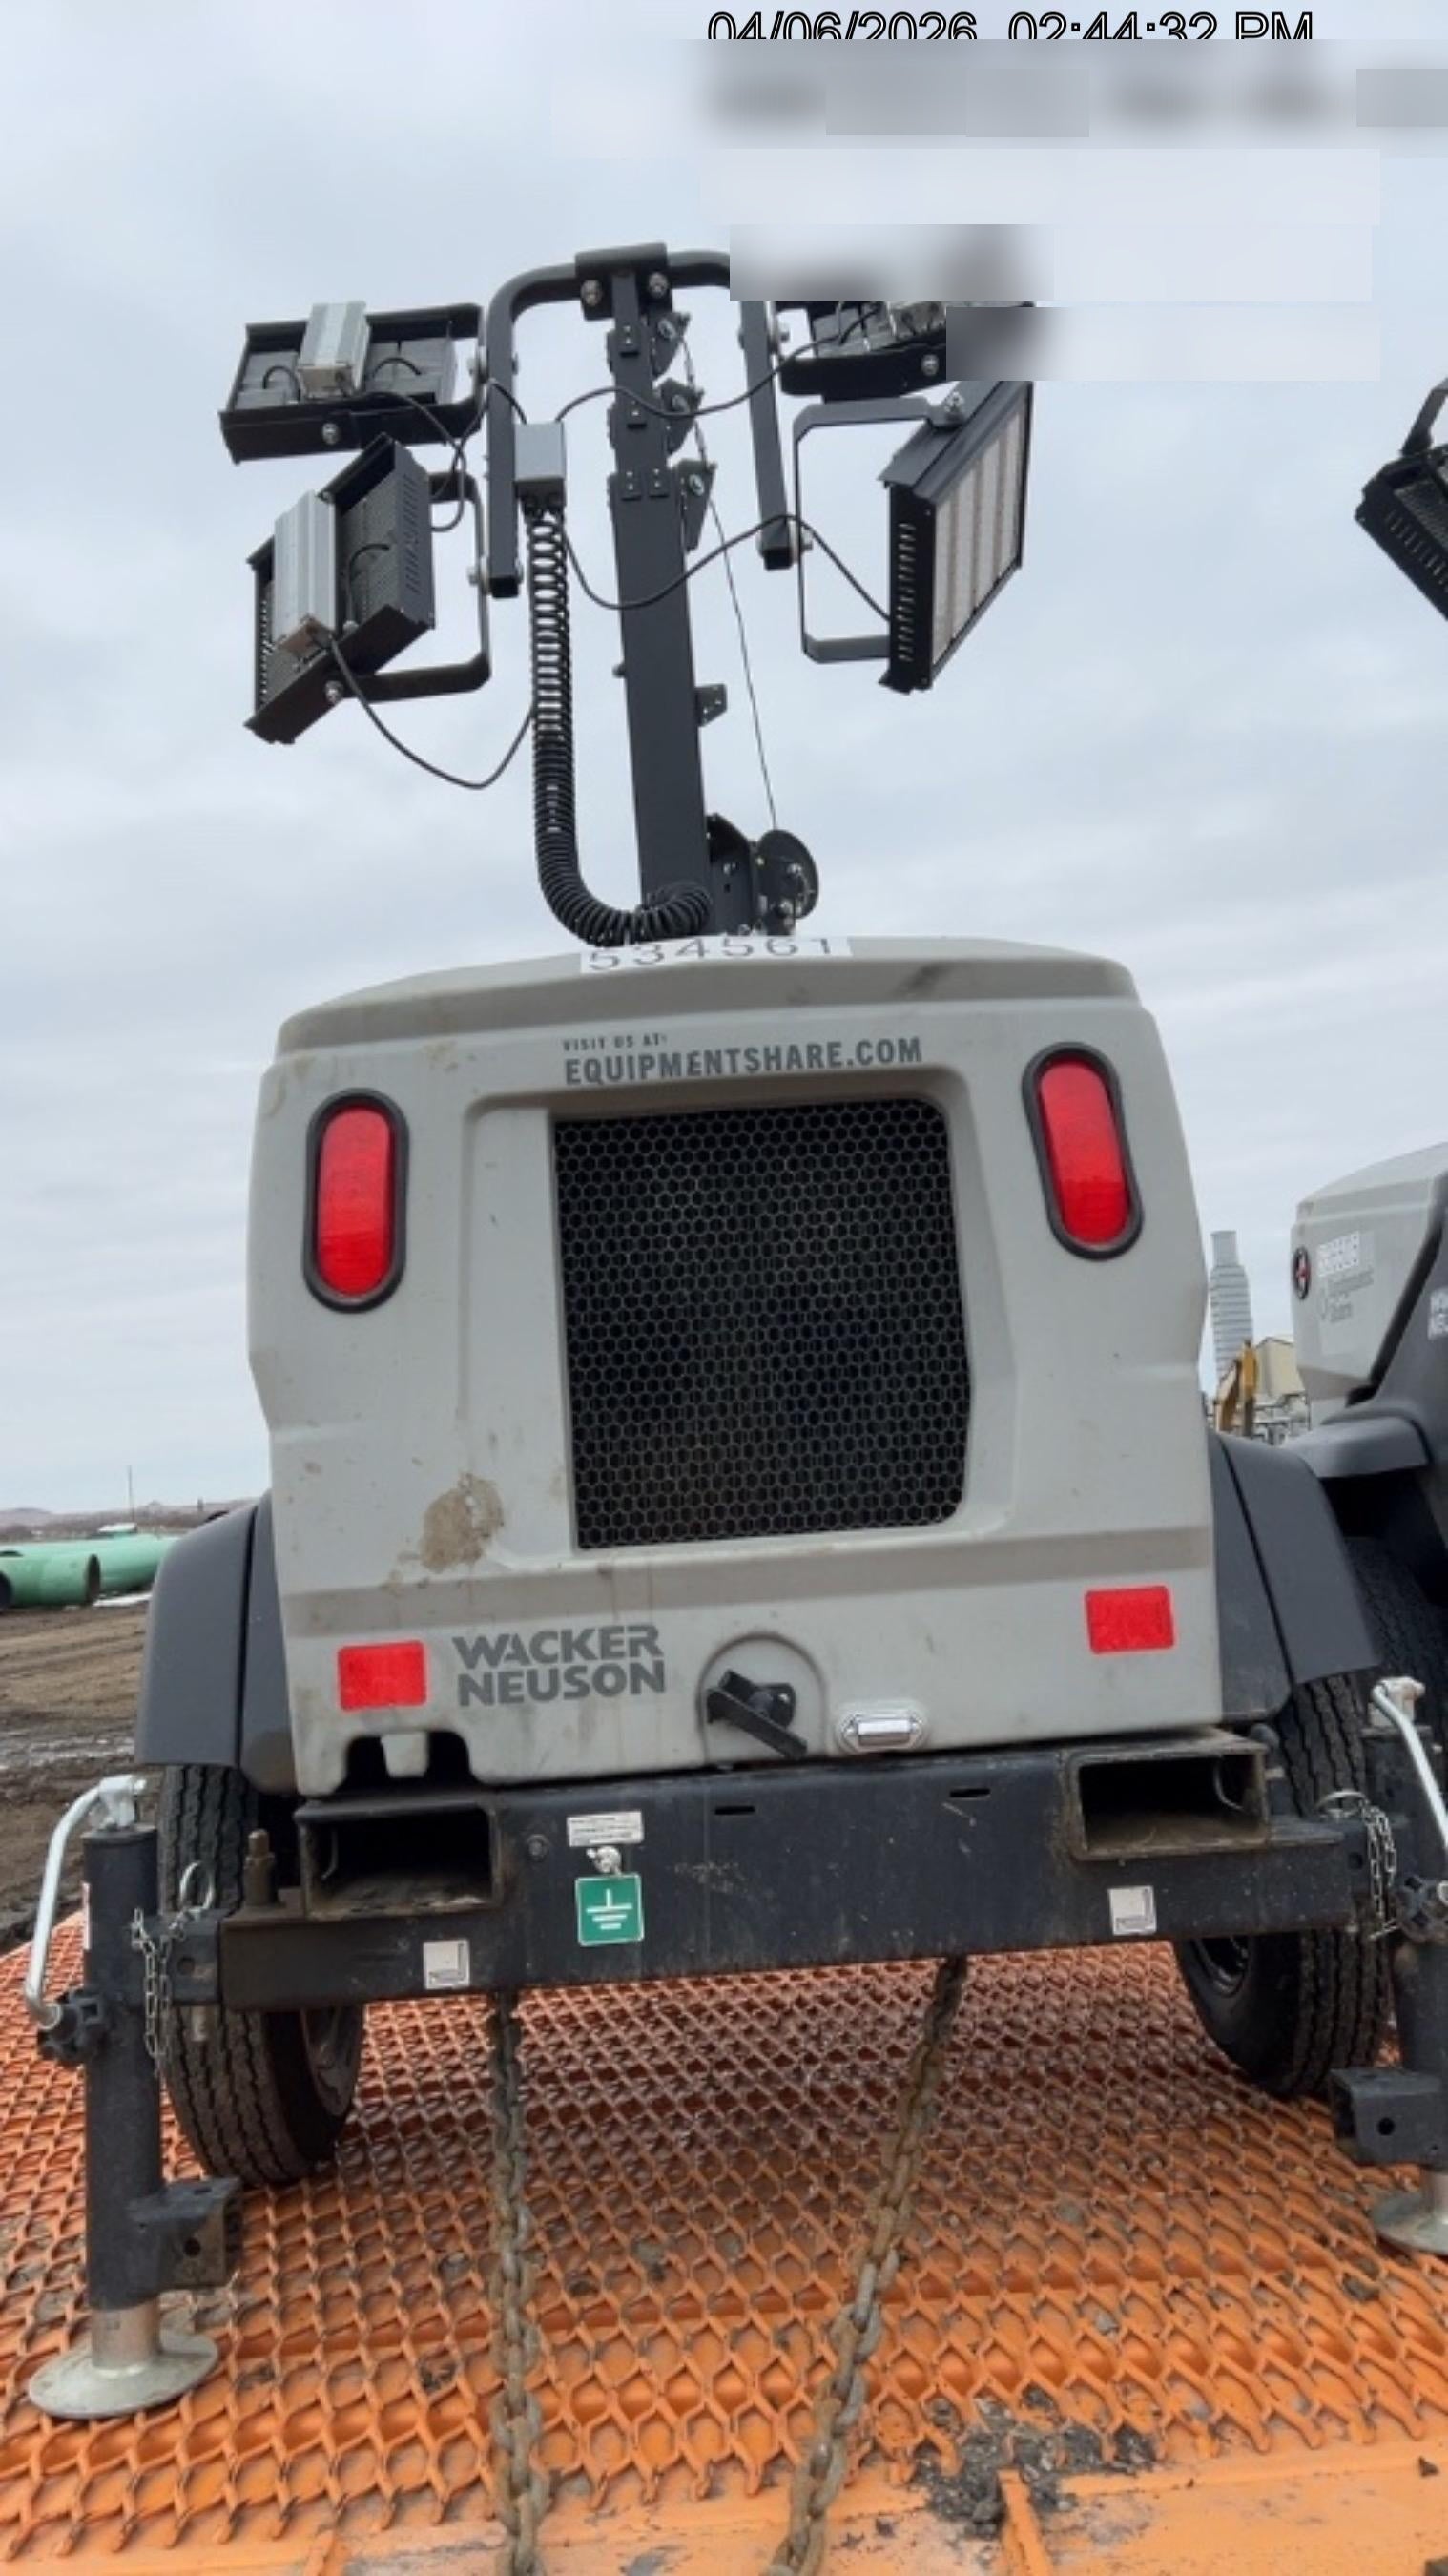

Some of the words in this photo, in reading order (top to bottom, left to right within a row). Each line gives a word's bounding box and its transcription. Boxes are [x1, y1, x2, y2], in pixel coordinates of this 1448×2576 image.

[589, 938, 832, 971] 534561
[563, 1038, 606, 1051] VISIT
[614, 1035, 633, 1049] US
[565, 1036, 921, 1085] EQUIPMENTSHARE.COM
[452, 1625, 664, 1669] WACKER
[459, 1660, 665, 1706] NEUSON
